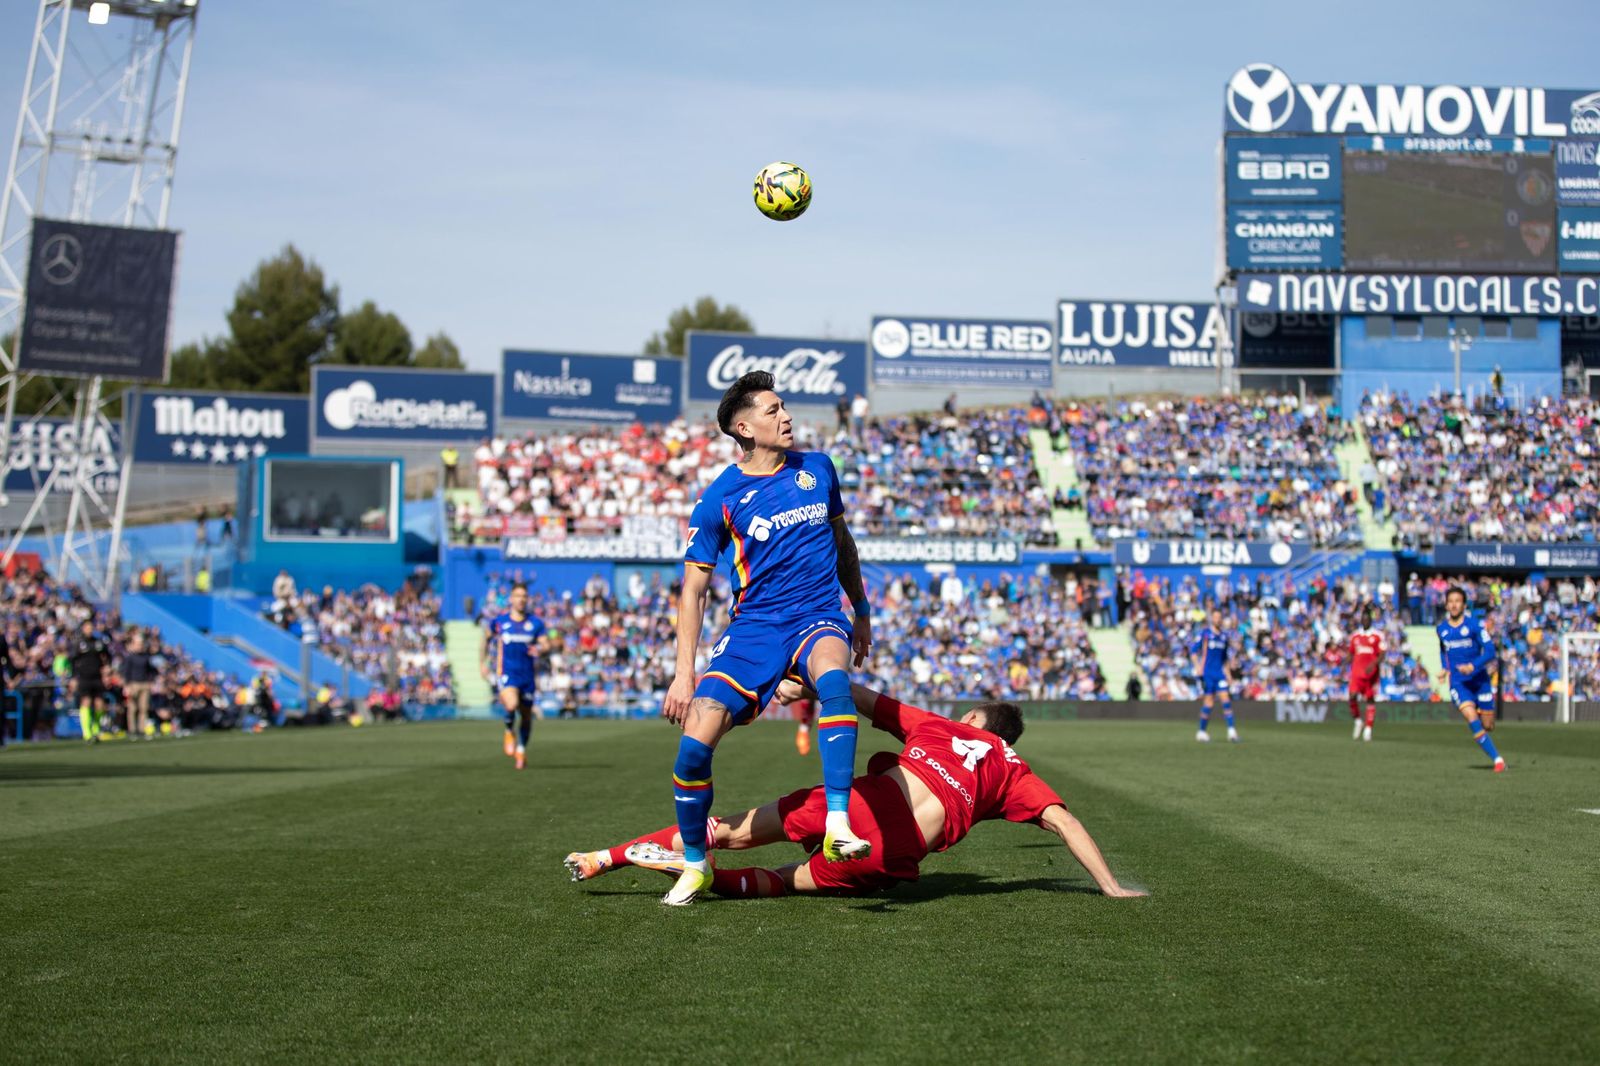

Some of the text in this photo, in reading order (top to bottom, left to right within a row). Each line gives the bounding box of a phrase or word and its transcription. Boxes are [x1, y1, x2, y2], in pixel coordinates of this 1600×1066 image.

[1296, 83, 1566, 136] YAMOVIL
[1404, 137, 1492, 152] arasport.es
[1238, 161, 1330, 180] EBRO
[1235, 222, 1334, 238] CHANGAN
[910, 322, 1052, 352] BLUE RED
[1059, 303, 1234, 348] LUJISA
[1060, 348, 1116, 365] AUNA
[513, 357, 592, 396] Nassica
[152, 396, 286, 438] Mahou
[0, 422, 120, 473] JISA
[770, 502, 828, 530] TECNOCASA
[954, 541, 975, 561] DE
[976, 541, 1017, 562] BLAS
[1169, 541, 1251, 564] LUJISA
[951, 736, 993, 772] 4
